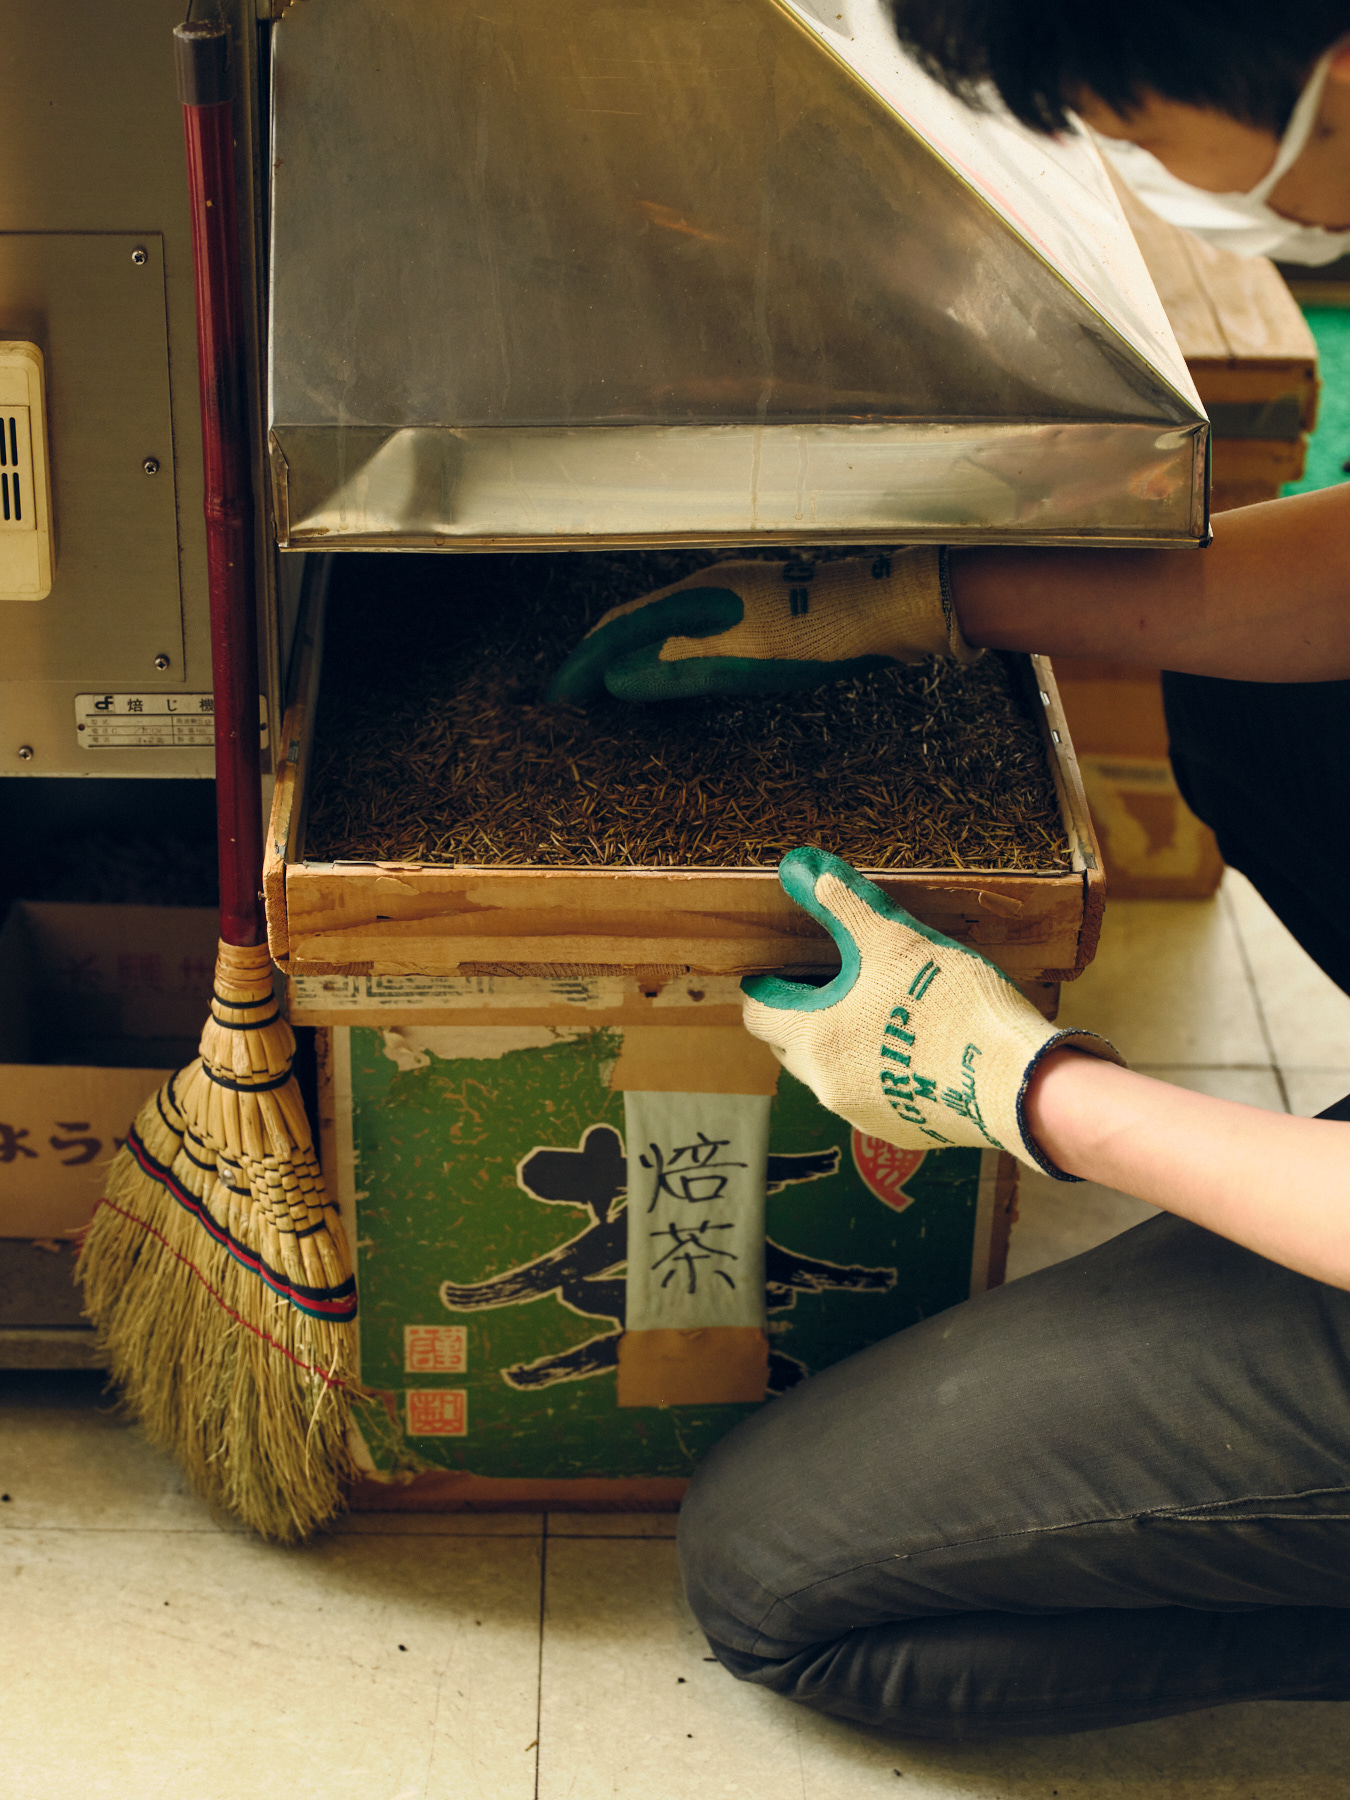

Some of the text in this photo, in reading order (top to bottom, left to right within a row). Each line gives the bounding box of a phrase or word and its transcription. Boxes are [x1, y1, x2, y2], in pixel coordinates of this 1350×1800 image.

[880, 1006, 926, 1125] GRIP
[912, 1072, 937, 1102] M
[638, 1132, 749, 1294] 焙茶
